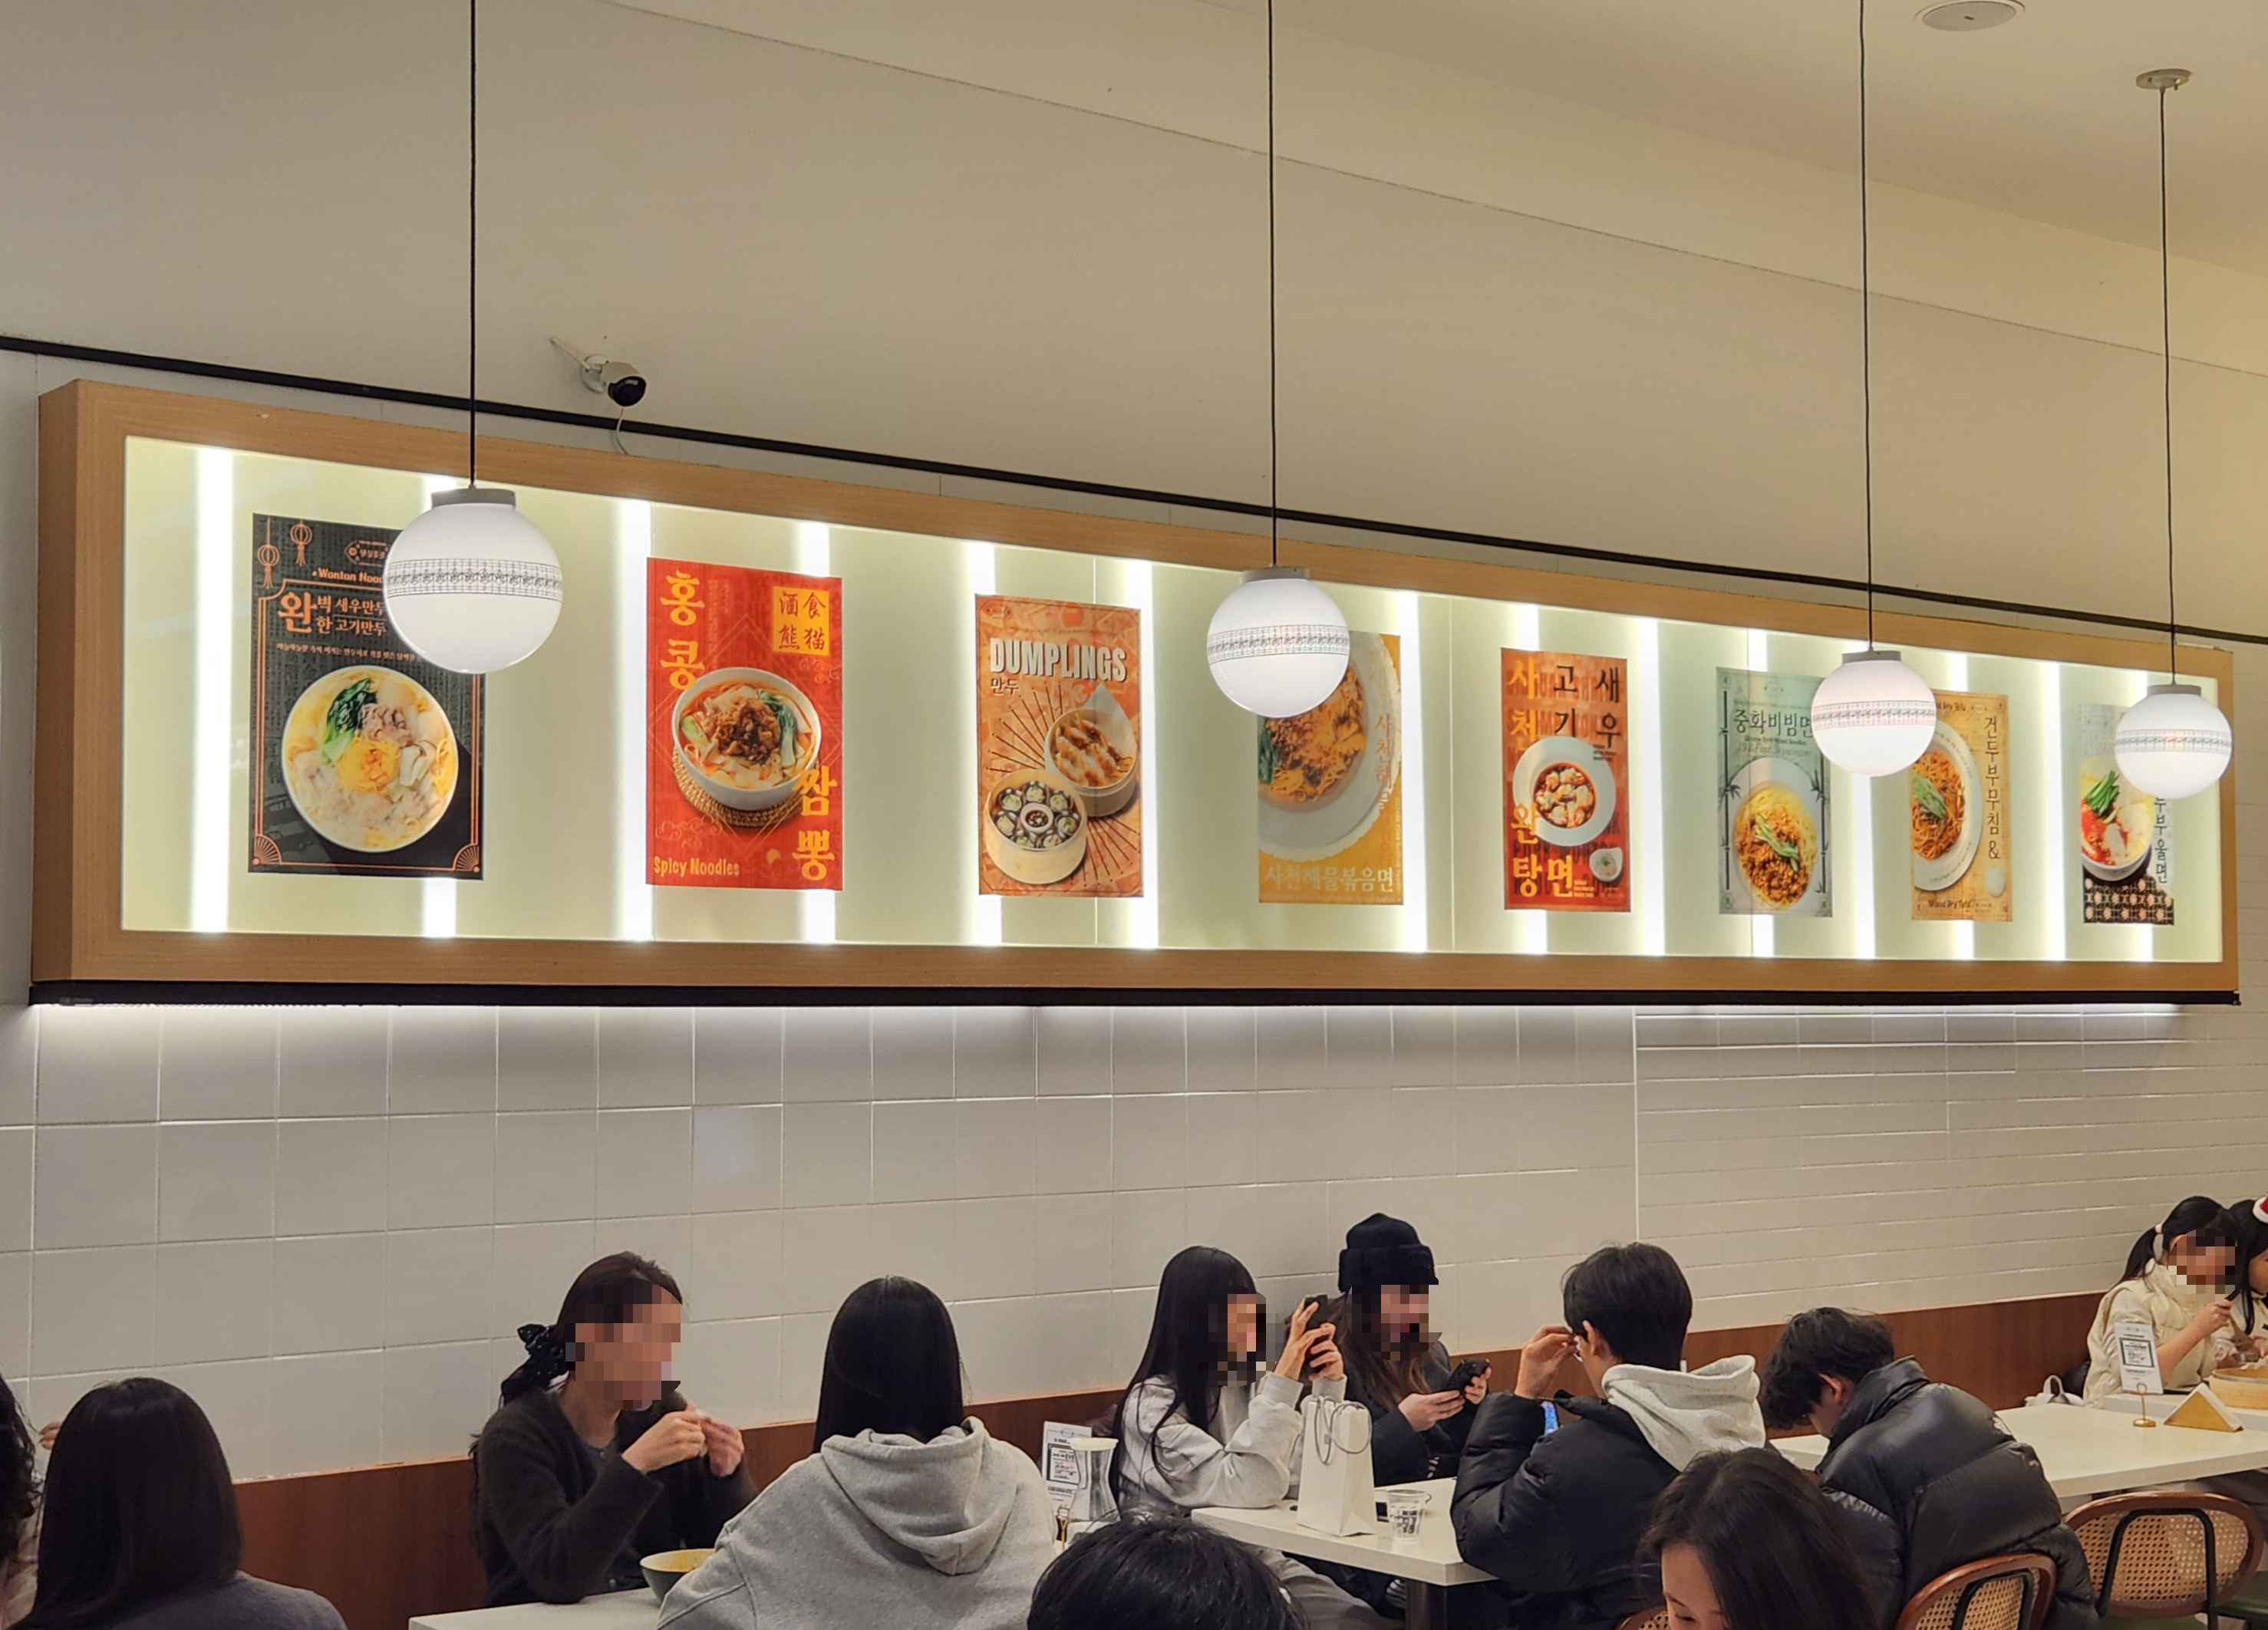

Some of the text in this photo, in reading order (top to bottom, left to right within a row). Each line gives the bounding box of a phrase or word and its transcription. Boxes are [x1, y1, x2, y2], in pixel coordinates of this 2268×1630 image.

[335, 618, 387, 637] 고기만두
[660, 570, 705, 690] 홍콩
[990, 637, 1126, 682] DUMPLINGS
[991, 677, 1019, 696] 만두
[1553, 665, 1577, 737] 고기
[1596, 667, 1621, 749] 새우
[1732, 710, 1813, 738] 중화비빔면
[792, 765, 837, 881] 짬뽕
[654, 855, 740, 878] Spicy Noodles
[1264, 864, 1393, 892] 사천해물볶음면
